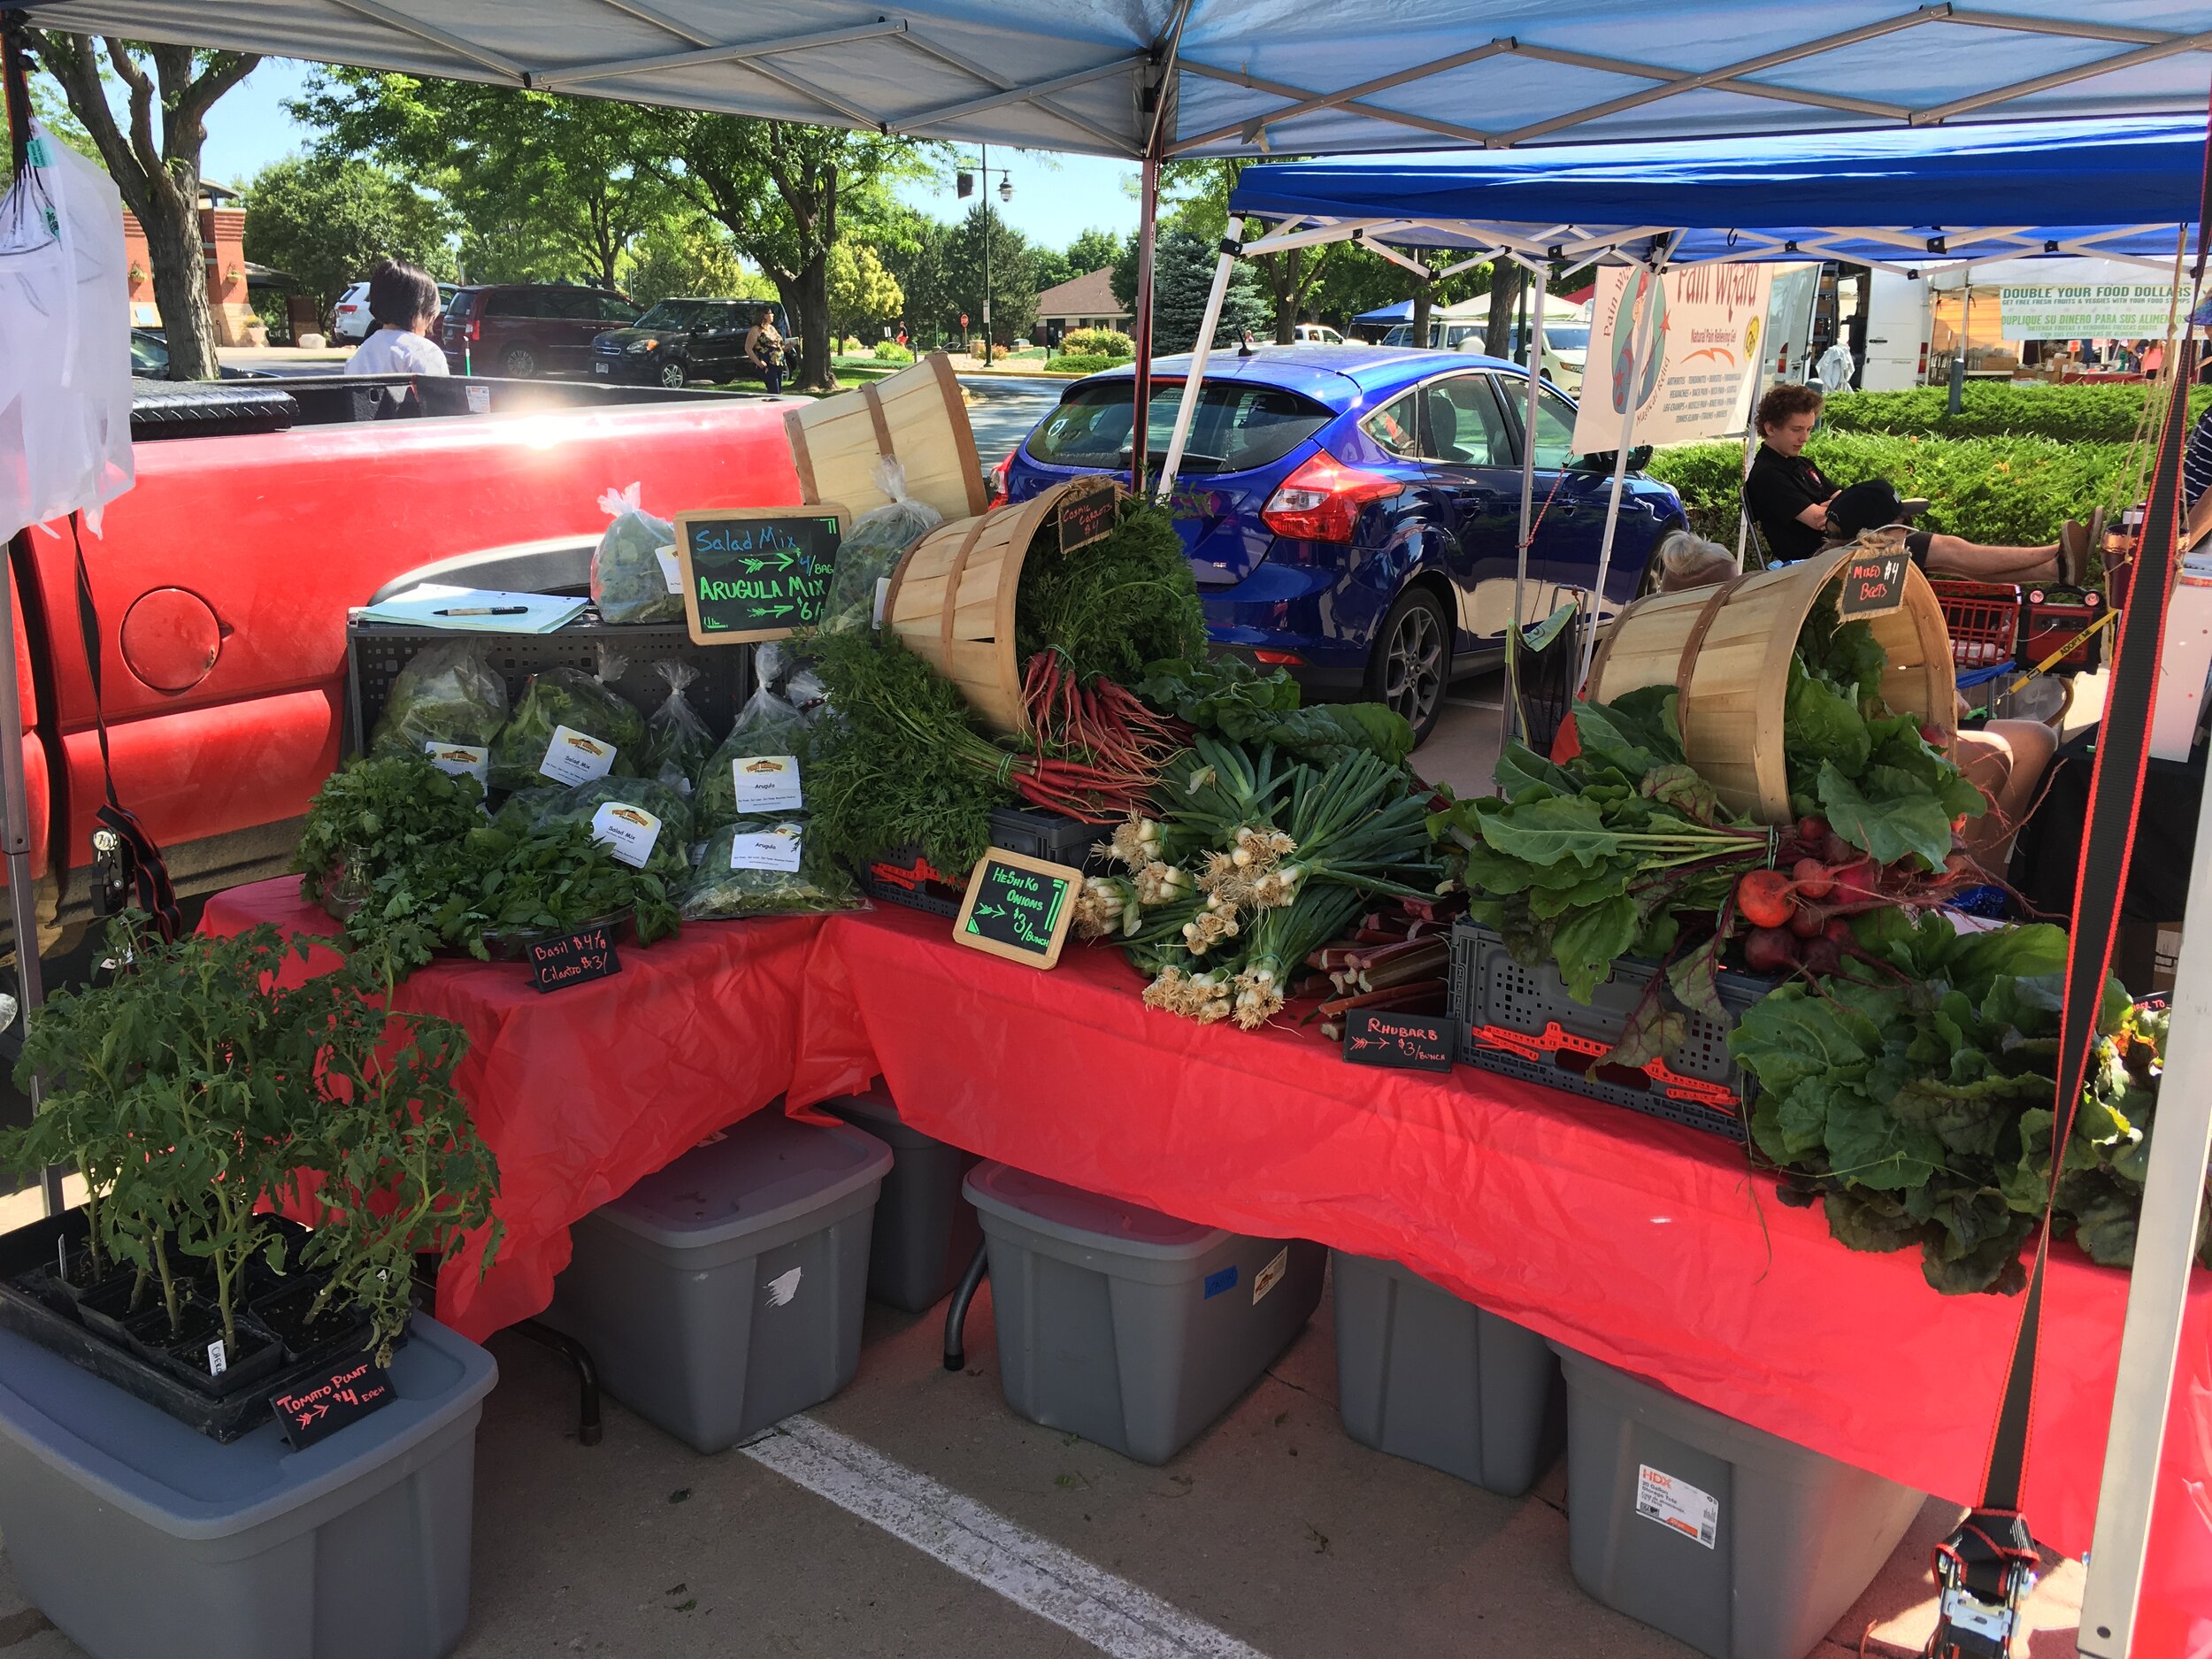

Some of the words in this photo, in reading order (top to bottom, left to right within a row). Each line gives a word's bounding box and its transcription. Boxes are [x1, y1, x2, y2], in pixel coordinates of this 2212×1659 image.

[2002, 288, 2053, 299] DOUBLE
[2057, 287, 2092, 298] YOUR
[2096, 286, 2130, 297] FOOD
[1603, 296, 1618, 337] Pain
[2001, 314, 2042, 326] DUPLIQUE
[2045, 314, 2056, 326] SU
[2059, 313, 2092, 325] DINERO
[2094, 313, 2117, 325] PARA
[2119, 313, 2137, 325] SUS
[695, 529, 754, 553] Salad
[758, 526, 799, 553] Mix
[1853, 565, 1881, 580] MIXED
[1884, 560, 1900, 585] $4
[699, 576, 784, 601] ARUGULA
[787, 575, 826, 598] MIX
[2059, 635, 2082, 656] ADOPT
[2082, 629, 2093, 639] ME
[565, 755, 580, 766] Salad
[580, 762, 591, 771] Mix
[608, 826, 625, 836] Salad
[625, 832, 636, 841] Mix
[755, 841, 777, 851] Arugula
[1006, 889, 1044, 912] ONIONS
[534, 941, 569, 962] Basil
[541, 965, 582, 984] Cilantro
[1366, 1017, 1440, 1041] RHUBARB
[275, 1386, 333, 1415] TOMATO
[330, 1363, 369, 1390] PLANT
[332, 1387, 359, 1407] $4
[360, 1386, 386, 1403] EACH
[1642, 1468, 1672, 1489] HDX
[1650, 1483, 1669, 1495] Gallon
